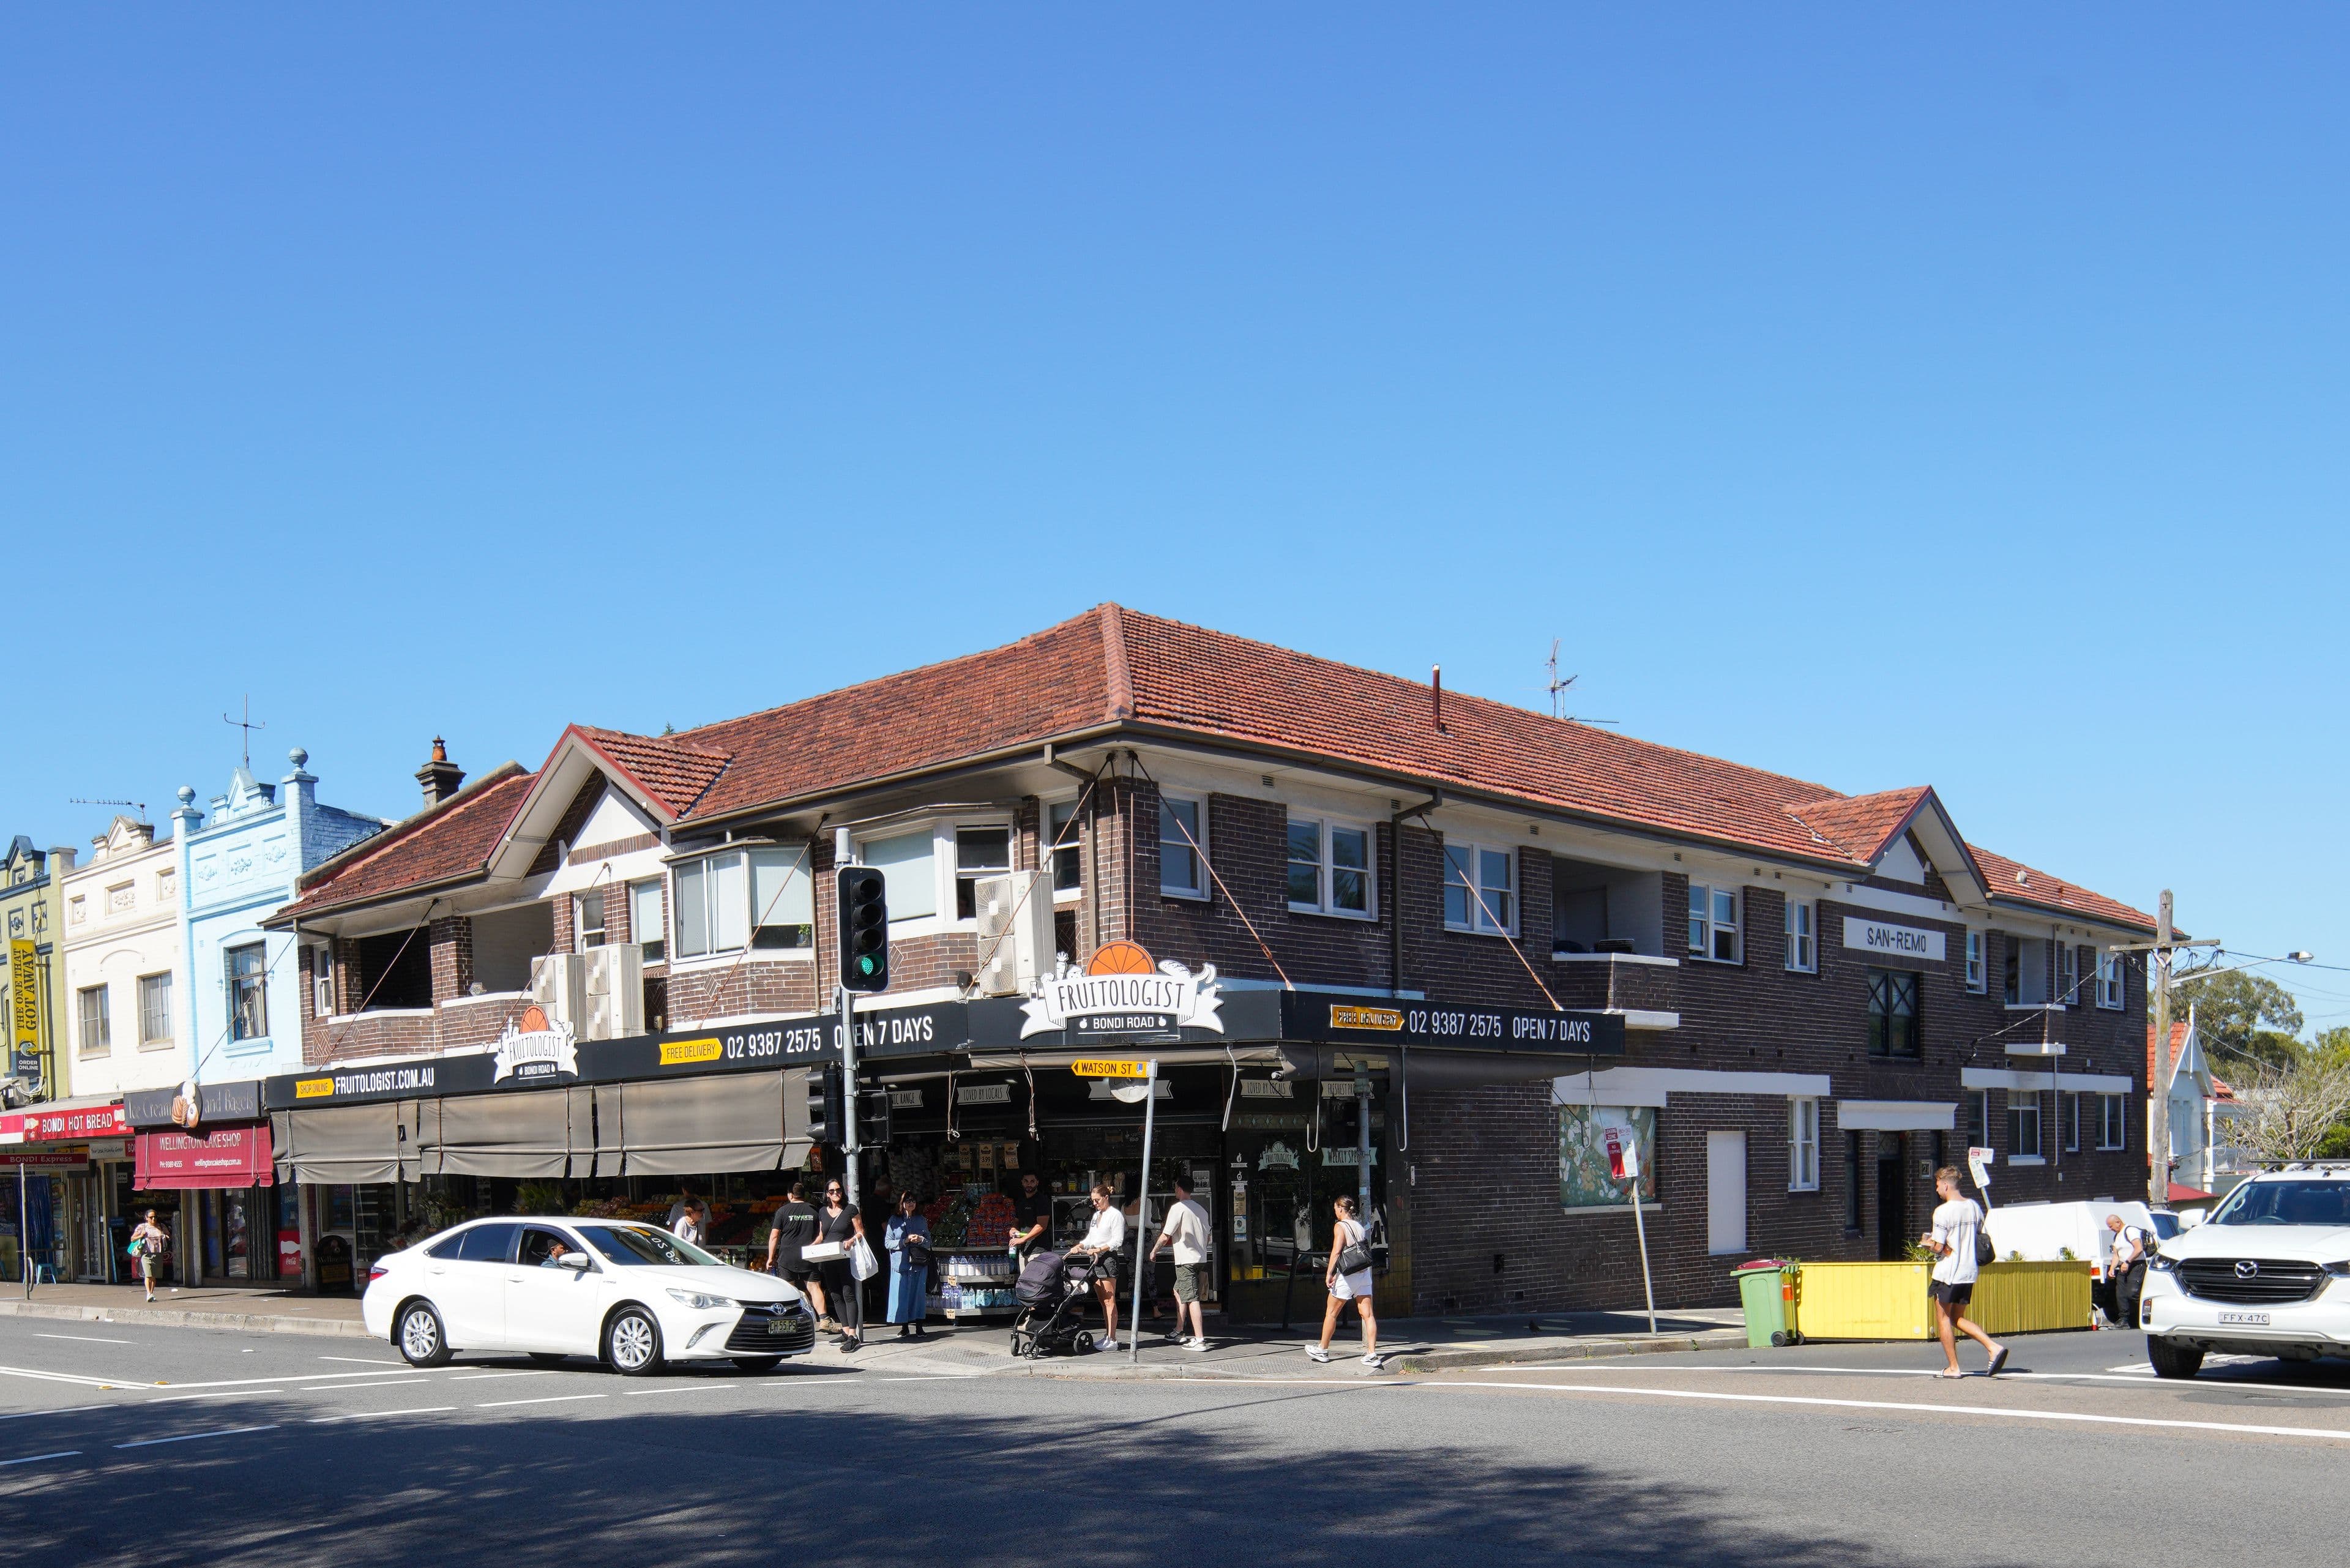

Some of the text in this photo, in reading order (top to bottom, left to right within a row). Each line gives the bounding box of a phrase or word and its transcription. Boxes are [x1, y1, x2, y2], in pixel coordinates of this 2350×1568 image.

[1868, 927, 1926, 952] SAN-REMO
[13, 948, 22, 976] THAT
[23, 949, 37, 1031] GOT AWAY
[1058, 979, 1185, 1012] FRUITOLOGIST
[16, 1007, 24, 1030] THE
[1093, 1017, 1154, 1029] BONDI ROAD
[1338, 1010, 1397, 1026] FREE DELIVERY
[1409, 1010, 1590, 1042] 02 9387 2575 OPEN 7 DAYS
[727, 1016, 933, 1059] 02 9387 2575 OEN 7 DAYS
[509, 1036, 561, 1062] FRUITOLOGIST
[667, 1043, 716, 1059] FREE DELIVERY
[524, 1064, 550, 1075] BONDI ROAD
[1081, 1062, 1132, 1075] WATSON ST
[300, 1083, 328, 1094] SHOP ONLINE
[335, 1067, 435, 1094] FRUITOLOGIST.COM.AU
[1247, 1082, 1286, 1094] LOVED BY LOCALS
[1327, 1083, 1347, 1095] FRESHEST
[900, 1092, 915, 1104] RANGE
[964, 1087, 1002, 1101] LOVED BY LOCALS
[128, 1089, 254, 1119] Ice Cream and Bagels
[42, 1117, 65, 1133] BONDI
[69, 1115, 84, 1130] HOT
[86, 1113, 113, 1129] BREAD
[160, 1133, 241, 1151] WELLINGTON CAKE SHOP
[1329, 1150, 1346, 1163] WEEKLY
